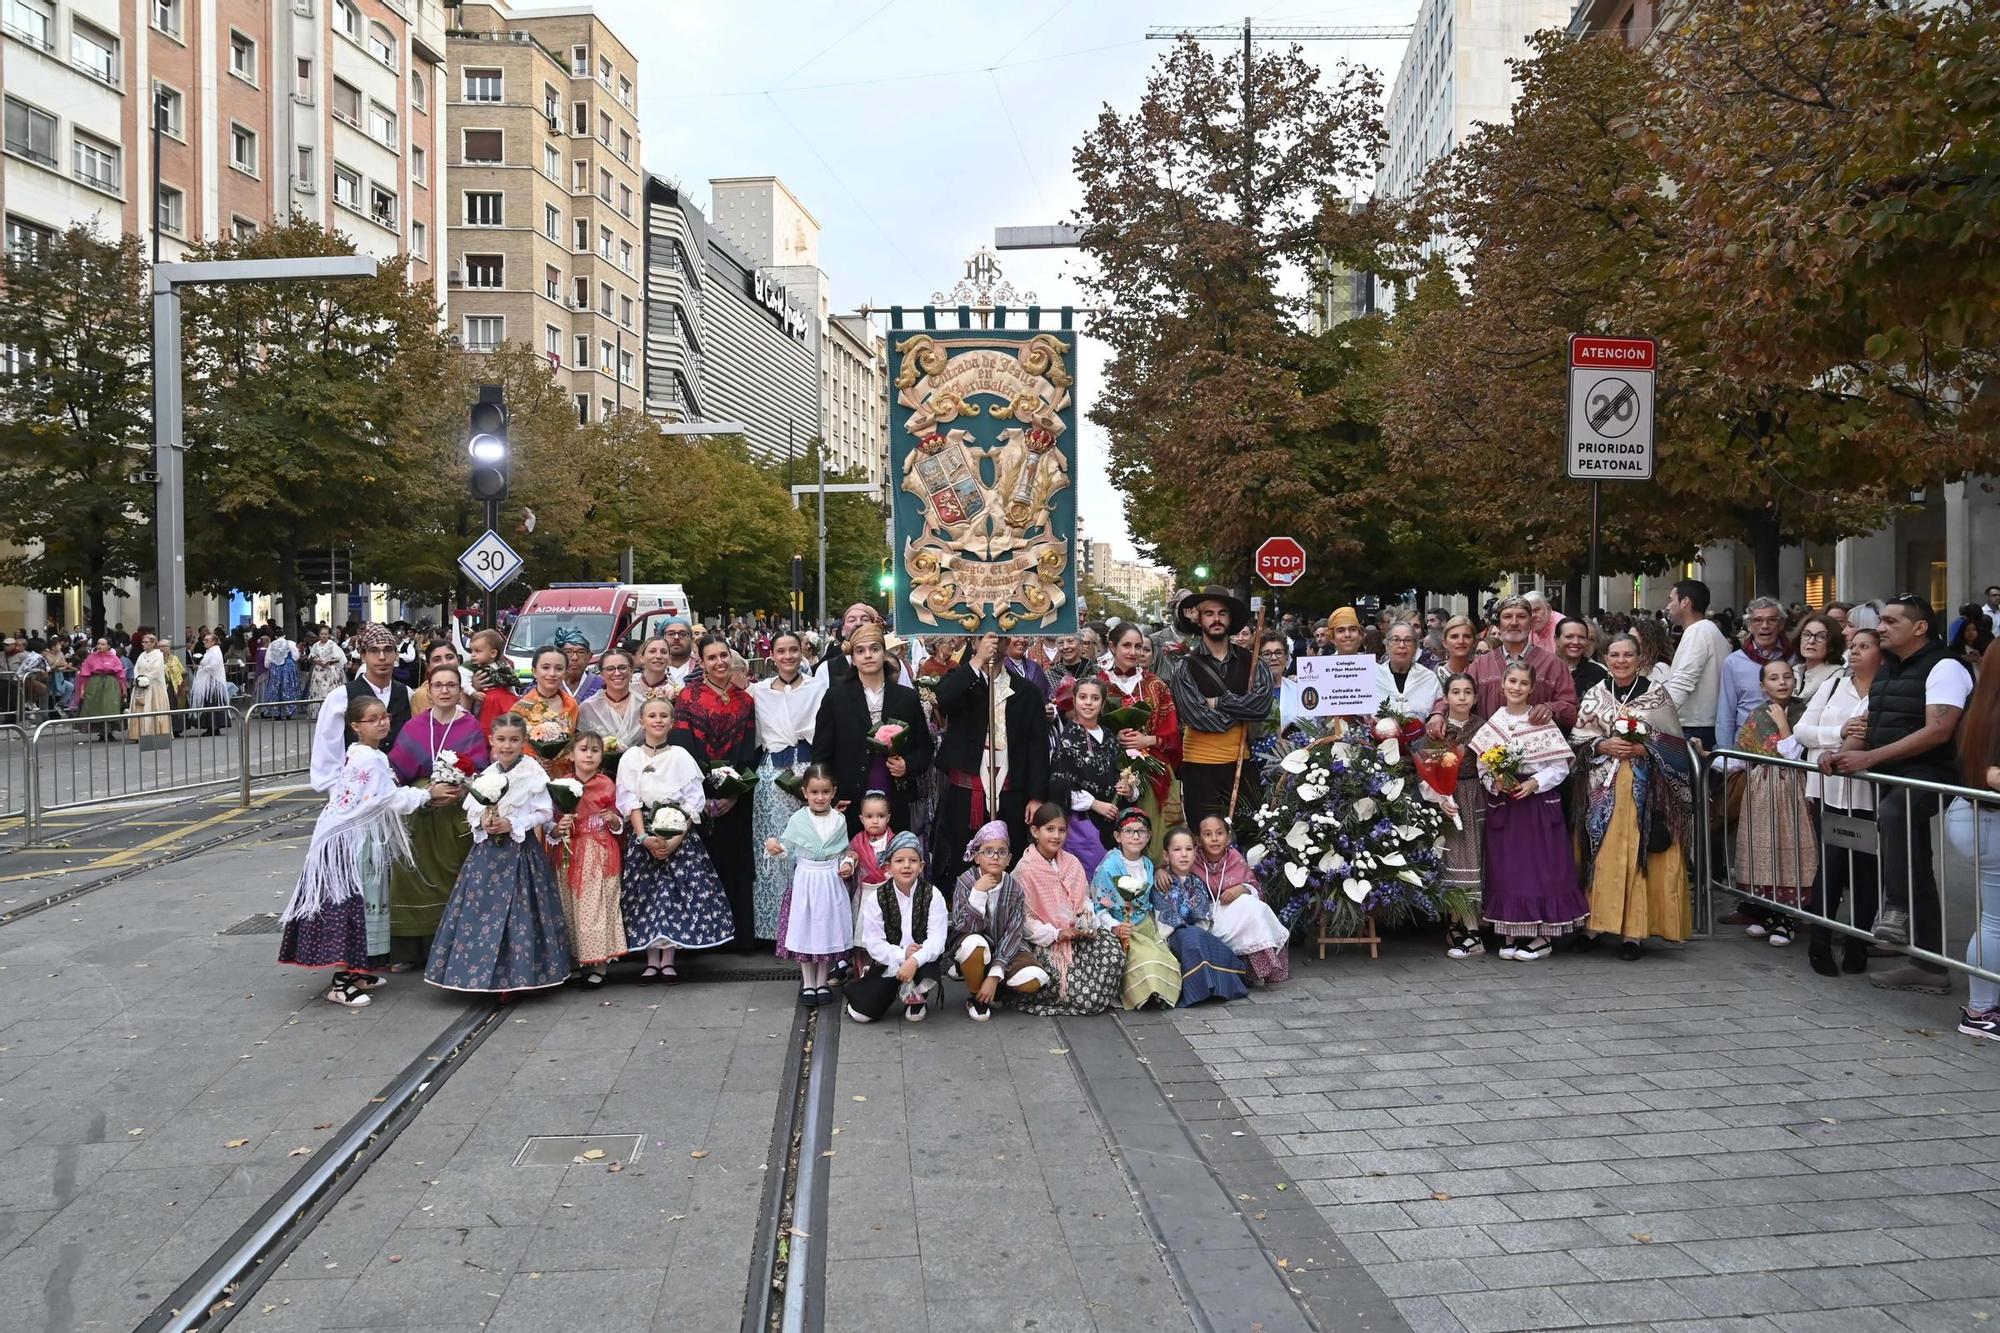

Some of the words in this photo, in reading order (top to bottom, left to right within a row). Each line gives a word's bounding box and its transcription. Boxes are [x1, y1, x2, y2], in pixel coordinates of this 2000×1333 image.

[1581, 346, 1646, 360] ATENCIÓN
[927, 358, 980, 389] Entrada
[982, 354, 997, 369] de
[978, 368, 993, 380] en
[1592, 394, 1633, 422] 20
[1578, 442, 1645, 455] PRIORIDAD
[1578, 459, 1643, 471] PEATONAL
[476, 550, 504, 571] 30
[1262, 555, 1300, 568] STOP
